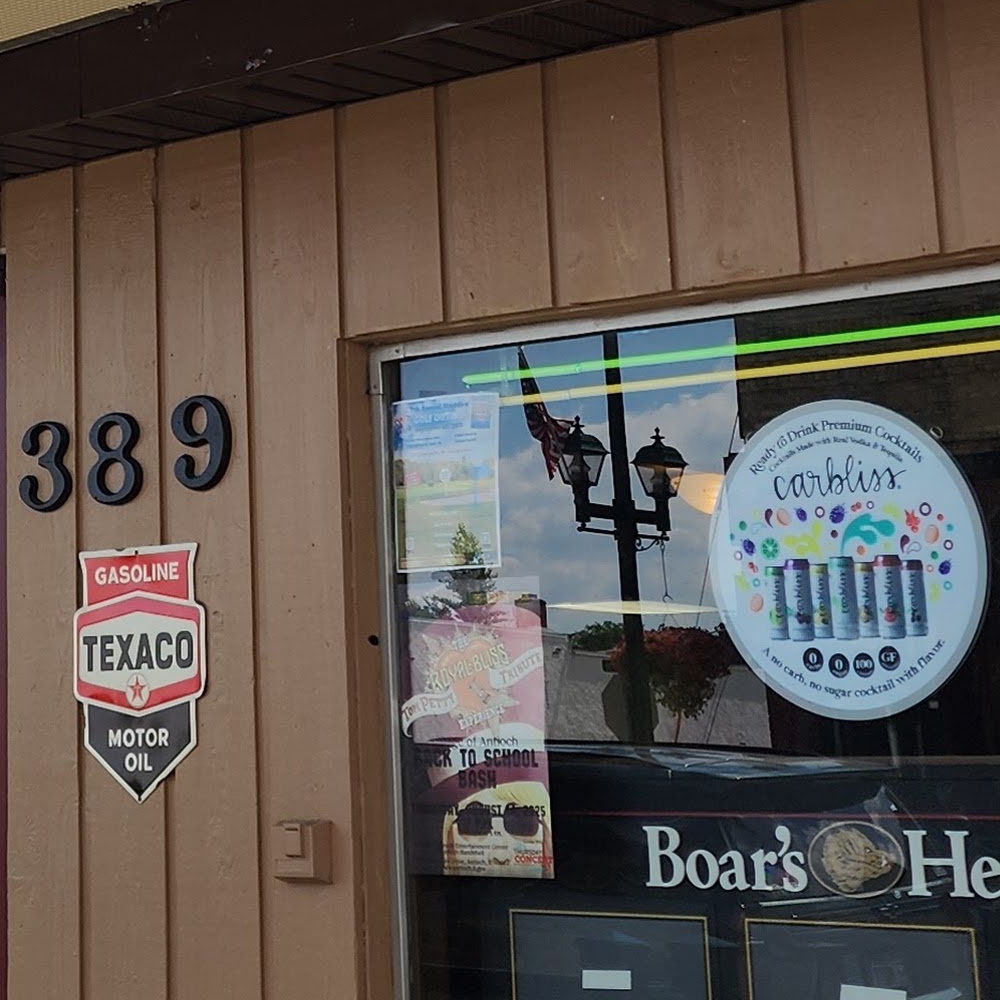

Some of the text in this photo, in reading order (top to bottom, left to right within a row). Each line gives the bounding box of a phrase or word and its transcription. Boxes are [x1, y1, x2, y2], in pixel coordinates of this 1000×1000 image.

[18, 395, 232, 513] 389
[749, 444, 777, 475] Ready
[787, 422, 820, 441] Drink
[821, 419, 872, 434] Premium
[874, 425, 924, 464] Cocktails
[773, 455, 907, 501] carbliss
[94, 561, 179, 586] GASOLINE
[82, 629, 194, 672] TEXACO
[499, 652, 543, 684] TRIBUTE
[855, 658, 873, 669] 100
[770, 656, 783, 668] no
[783, 665, 807, 686] carb,
[809, 681, 822, 692] no
[824, 686, 851, 699] sugar
[854, 679, 896, 698] cocktail
[896, 666, 920, 685] with
[420, 693, 456, 713] PETTY
[107, 727, 169, 749] MOTOR
[481, 736, 519, 748] Antioch
[124, 753, 153, 773] OIL
[460, 748, 477, 768] TO
[483, 748, 539, 768] SCHOOL
[458, 769, 497, 789] BASH
[642, 825, 808, 893] Boar's
